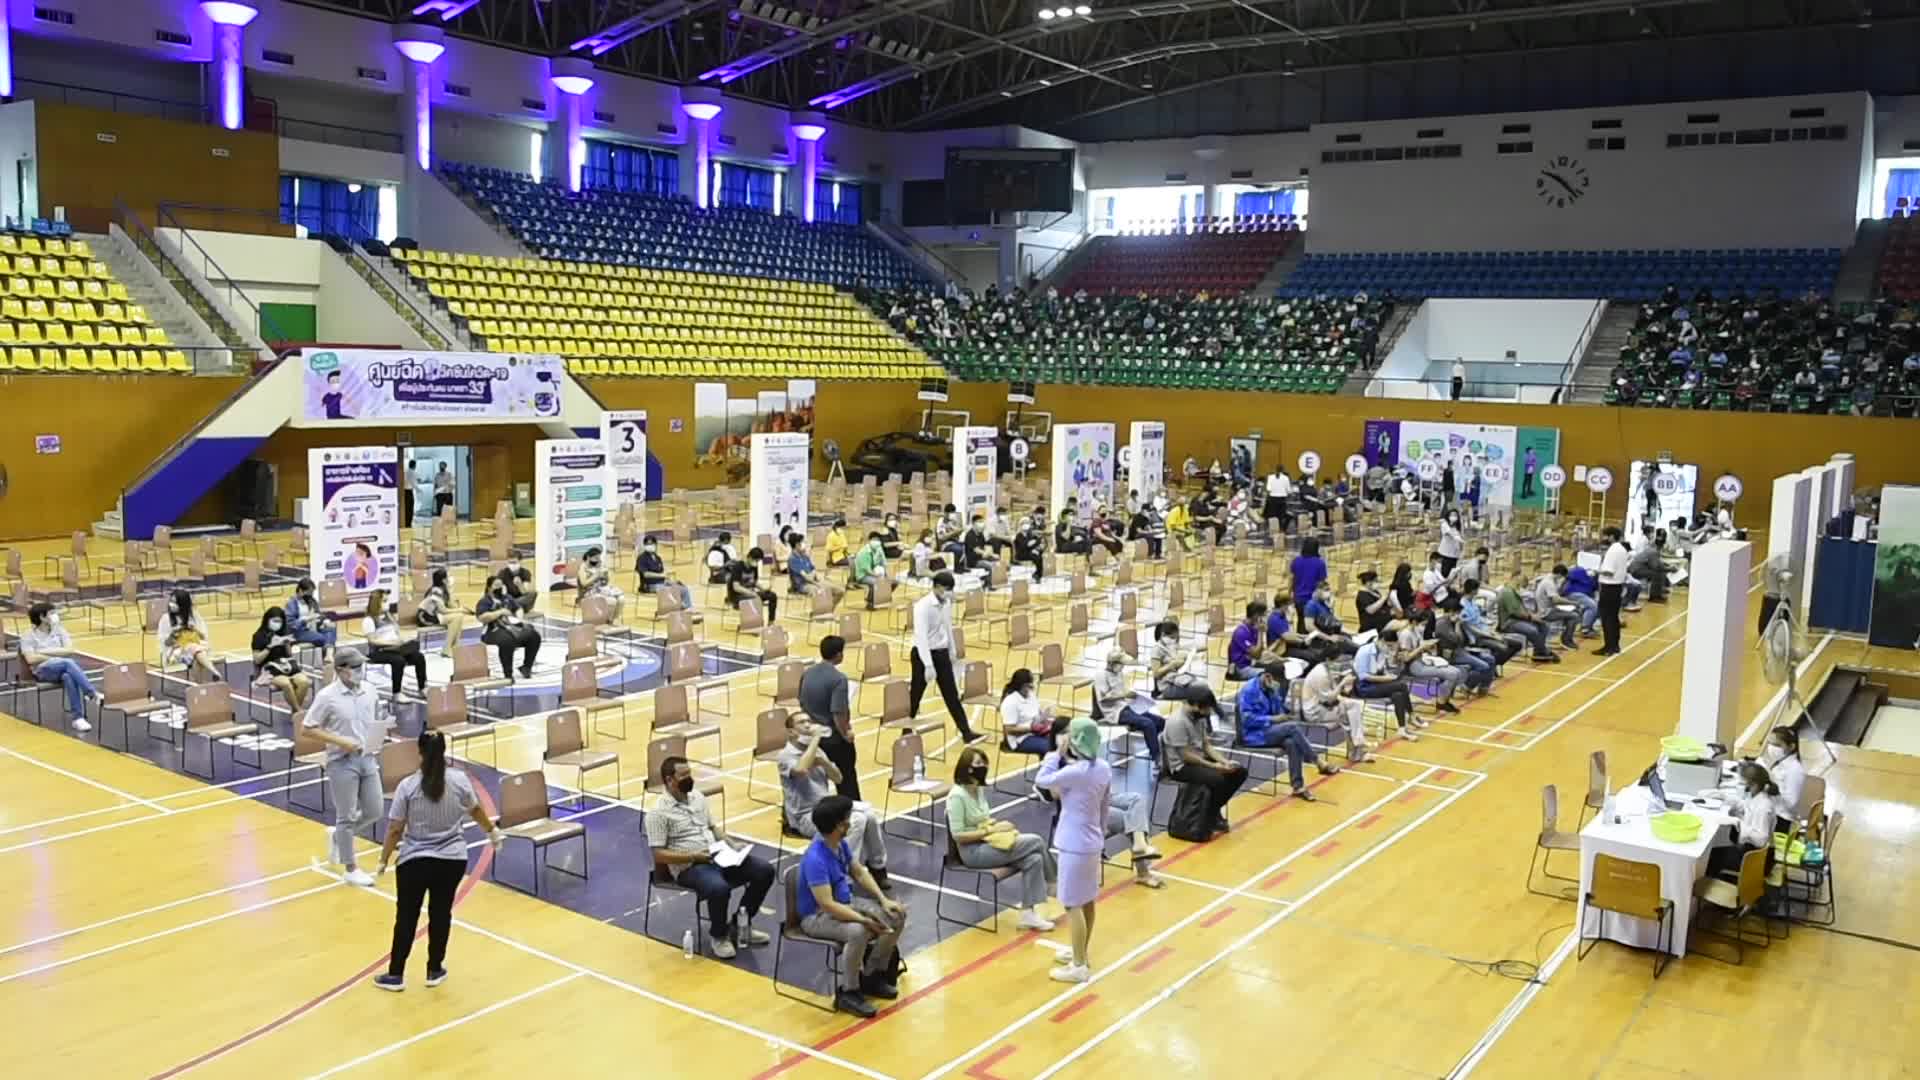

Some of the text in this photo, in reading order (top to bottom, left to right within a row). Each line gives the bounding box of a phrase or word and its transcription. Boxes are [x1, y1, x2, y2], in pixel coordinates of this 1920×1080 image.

[468, 379, 486, 395] 33
[622, 427, 635, 453] 3
[1015, 443, 1023, 454] B
[1305, 457, 1314, 468] E
[1352, 460, 1361, 471] F
[1421, 464, 1434, 473] FF
[1485, 468, 1499, 478] EE
[1544, 472, 1561, 482] DD
[1590, 475, 1607, 485] CC
[1657, 479, 1674, 489] BB
[1718, 482, 1738, 493] AA
